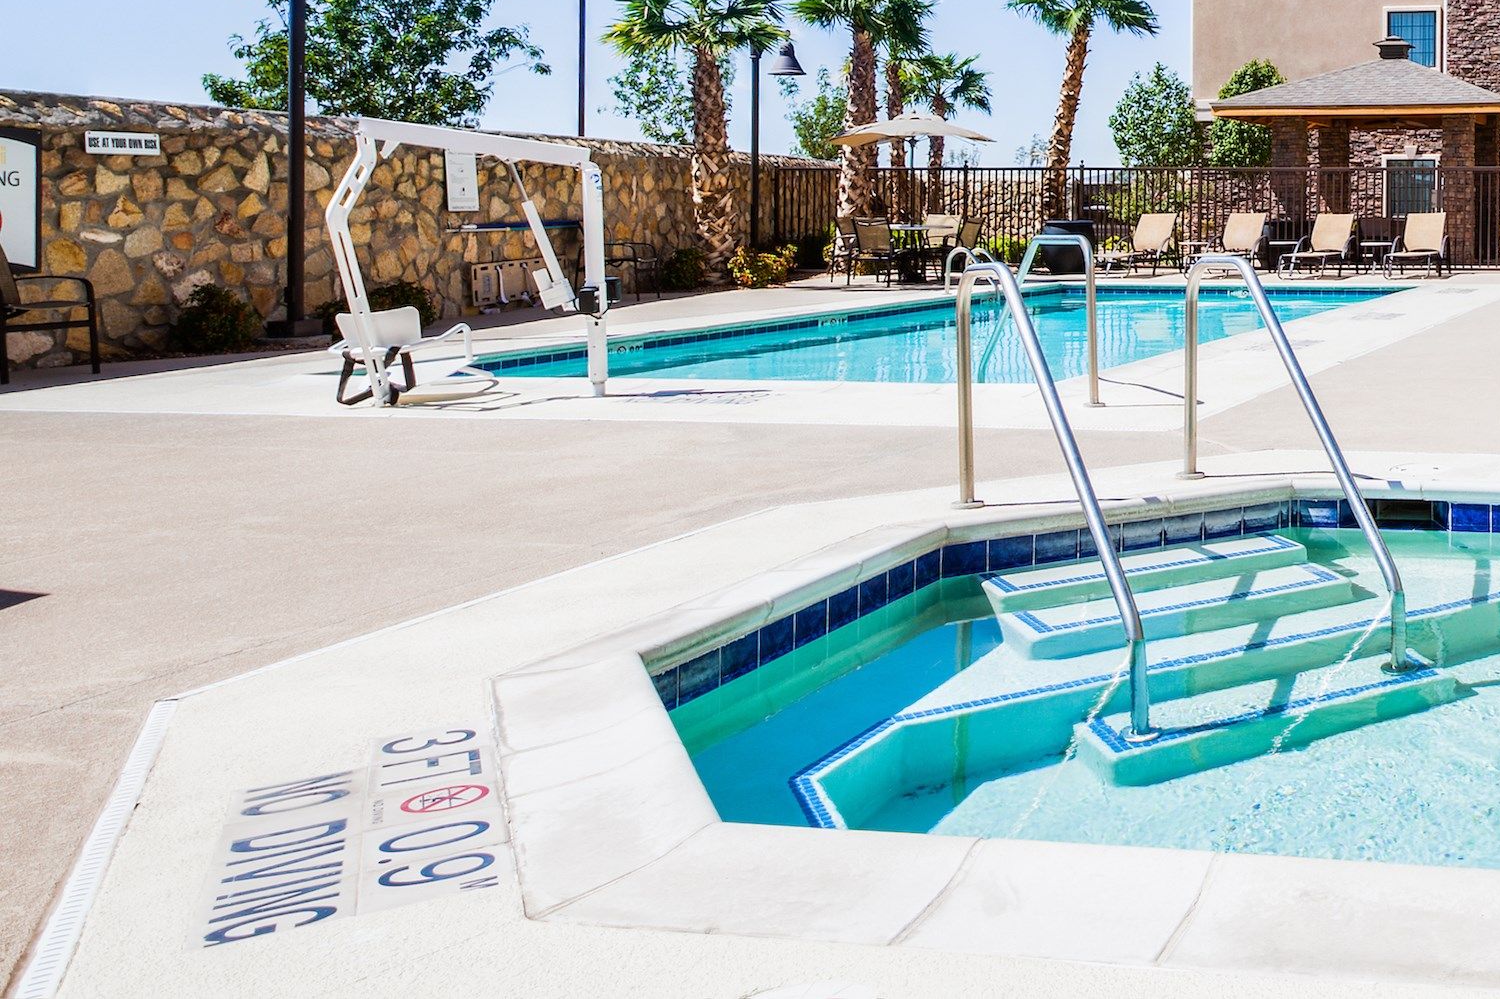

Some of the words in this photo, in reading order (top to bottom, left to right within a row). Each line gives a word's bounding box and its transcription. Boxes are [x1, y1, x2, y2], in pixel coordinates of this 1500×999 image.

[88, 137, 100, 147] USE
[102, 137, 110, 147] AT
[111, 138, 127, 148] YOUR
[128, 138, 143, 148] OWN
[144, 139, 157, 149] RISK
[240, 770, 353, 817] NO
[203, 818, 348, 948] DIVING
